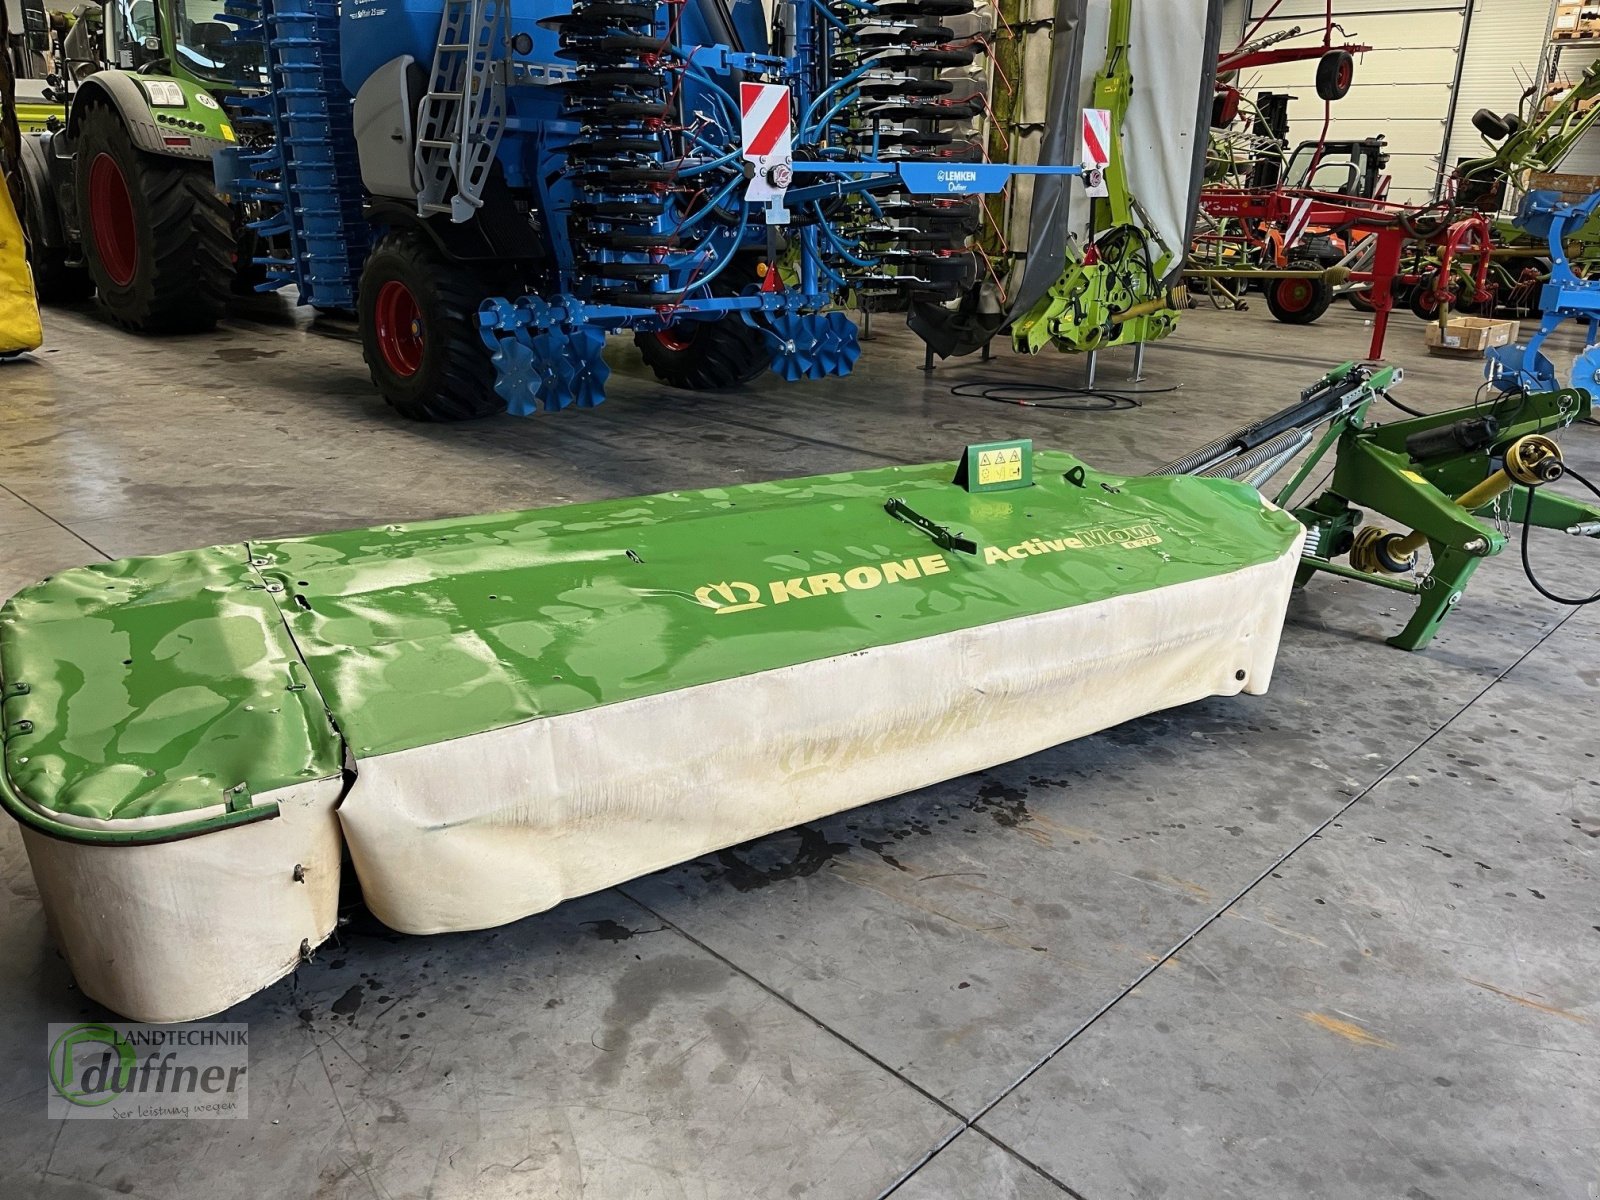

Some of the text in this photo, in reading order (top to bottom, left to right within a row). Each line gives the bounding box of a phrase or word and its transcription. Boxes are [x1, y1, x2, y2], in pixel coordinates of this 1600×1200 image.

[945, 171, 976, 181] LEMKEN
[1126, 541, 1135, 549] R
[768, 524, 1157, 605] KRONE ActiveMow
